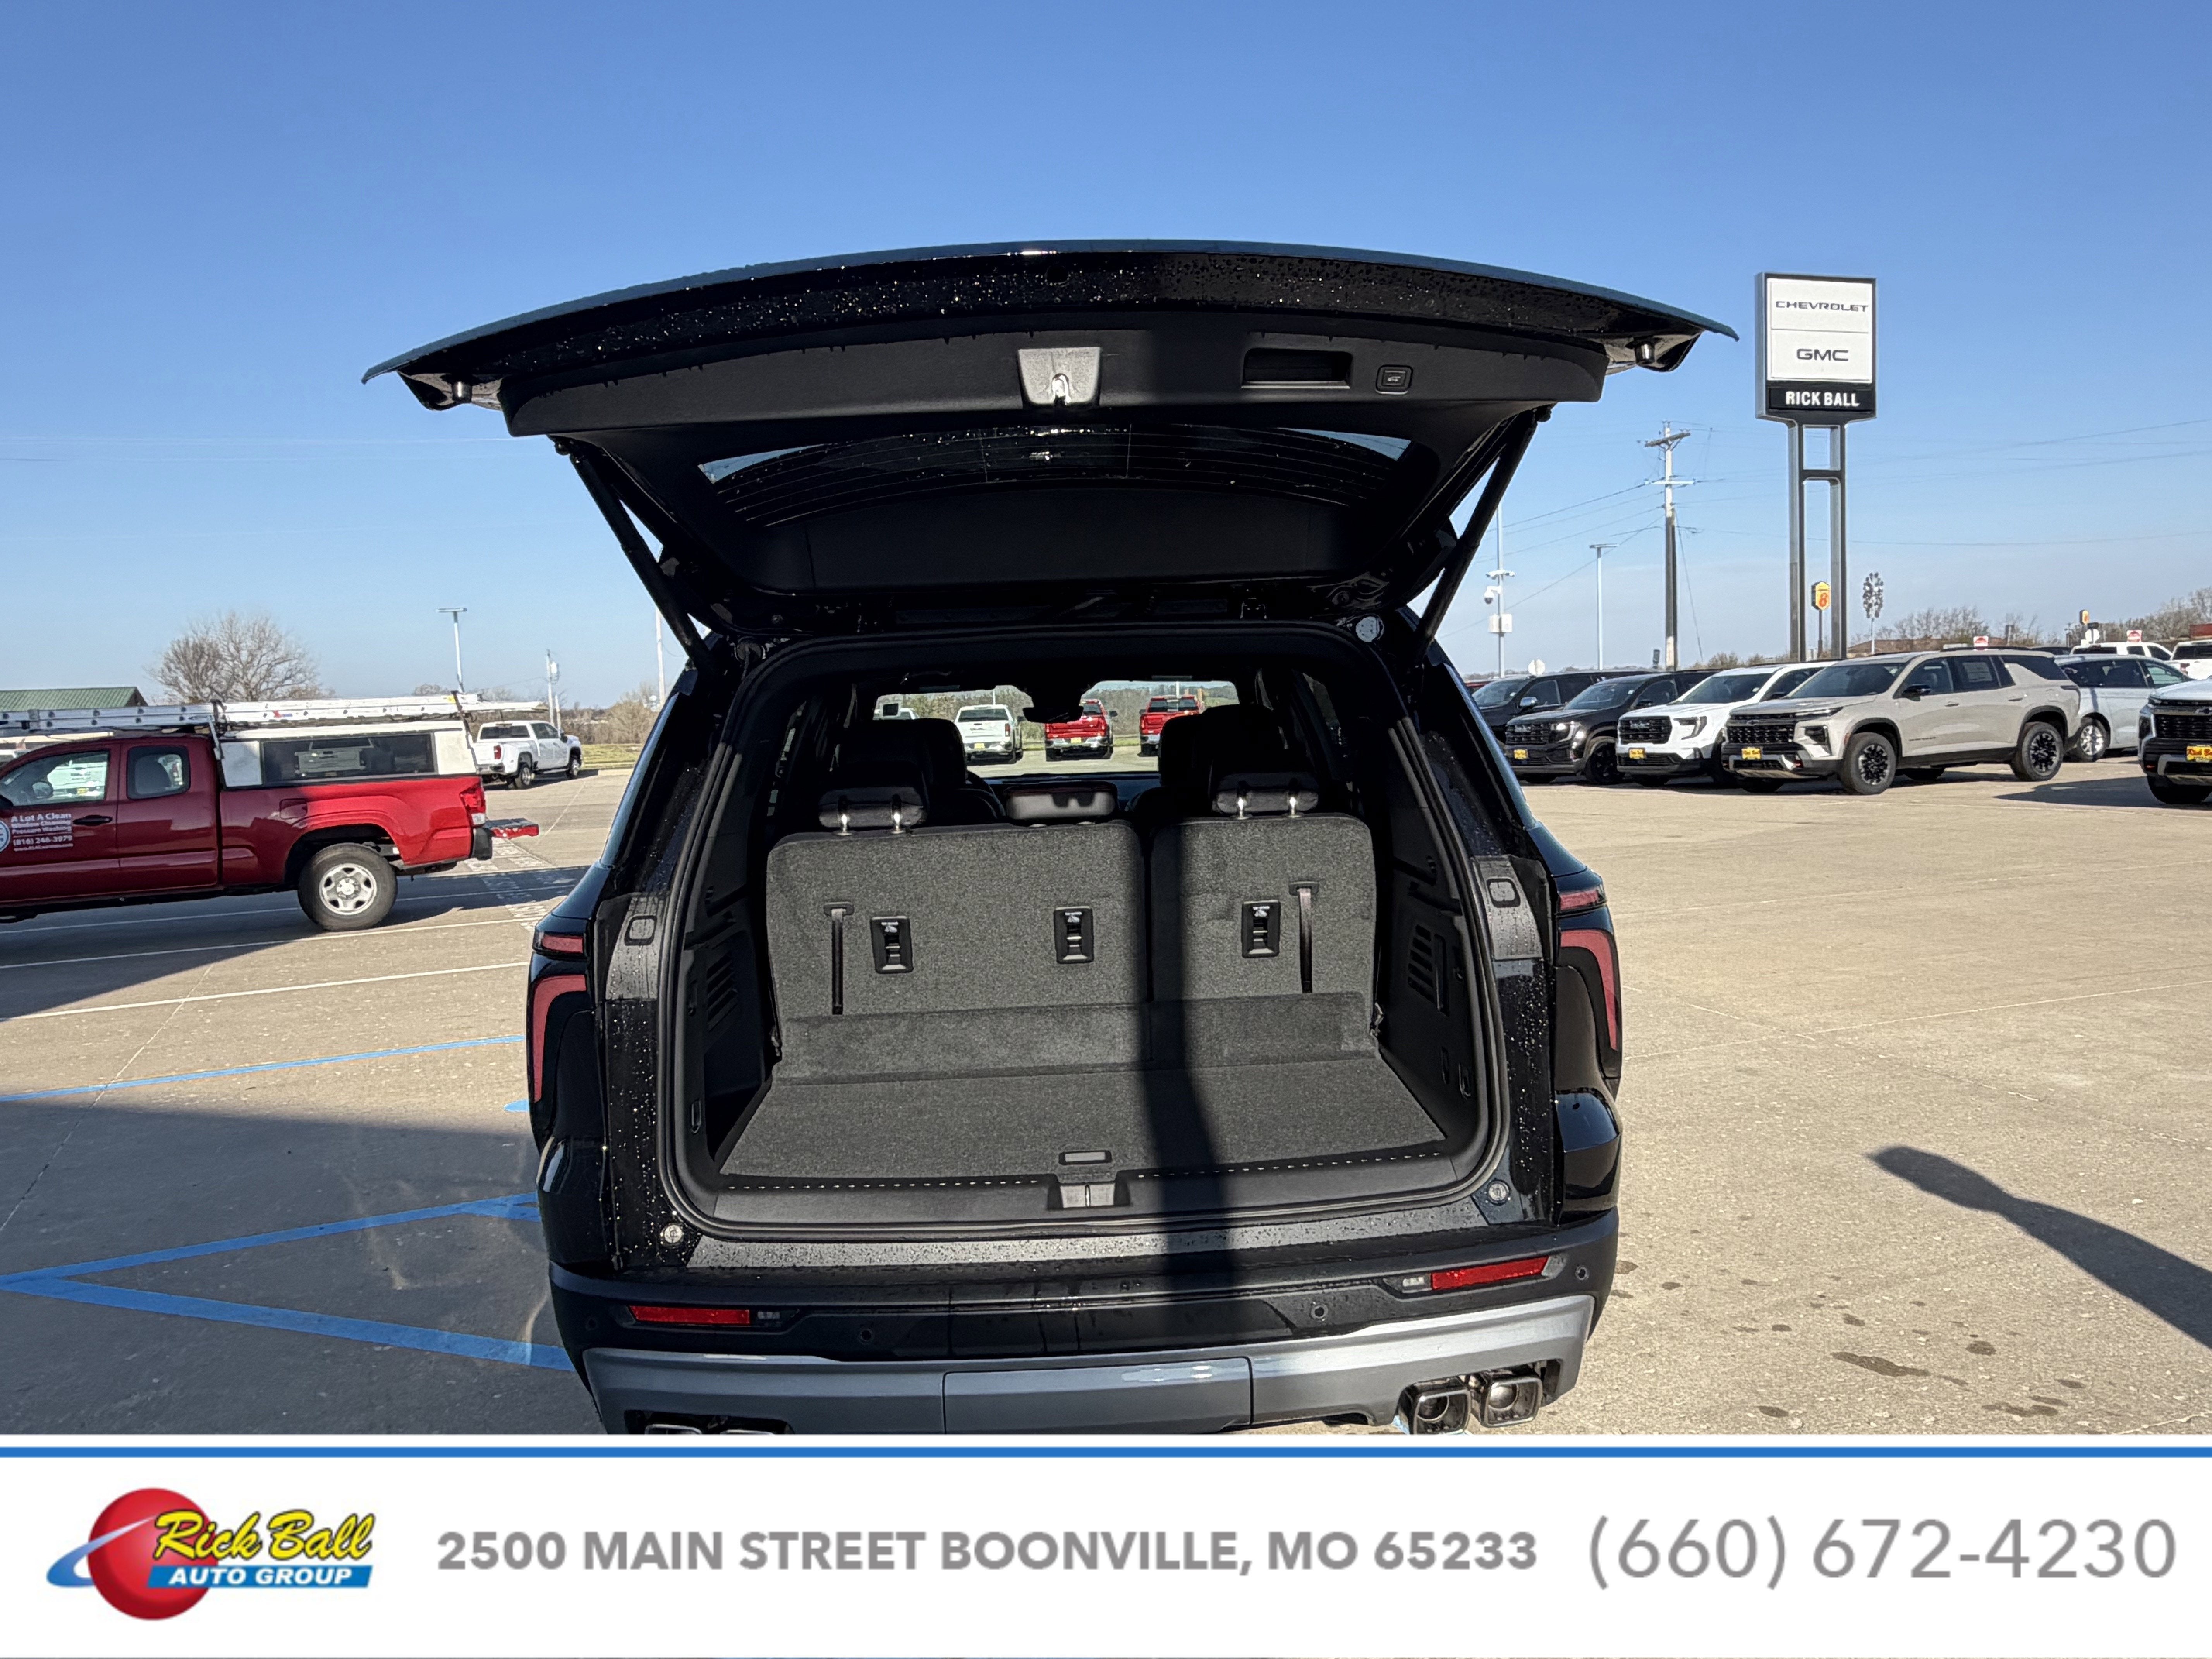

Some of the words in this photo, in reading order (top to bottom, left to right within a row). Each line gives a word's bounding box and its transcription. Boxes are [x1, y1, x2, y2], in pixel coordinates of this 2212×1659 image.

[1776, 301, 1869, 312] CHEVROLET
[1796, 348, 1849, 361] GMC
[1786, 390, 1821, 405] RICK
[1824, 392, 1860, 407] BALL
[1819, 592, 1827, 607] 8
